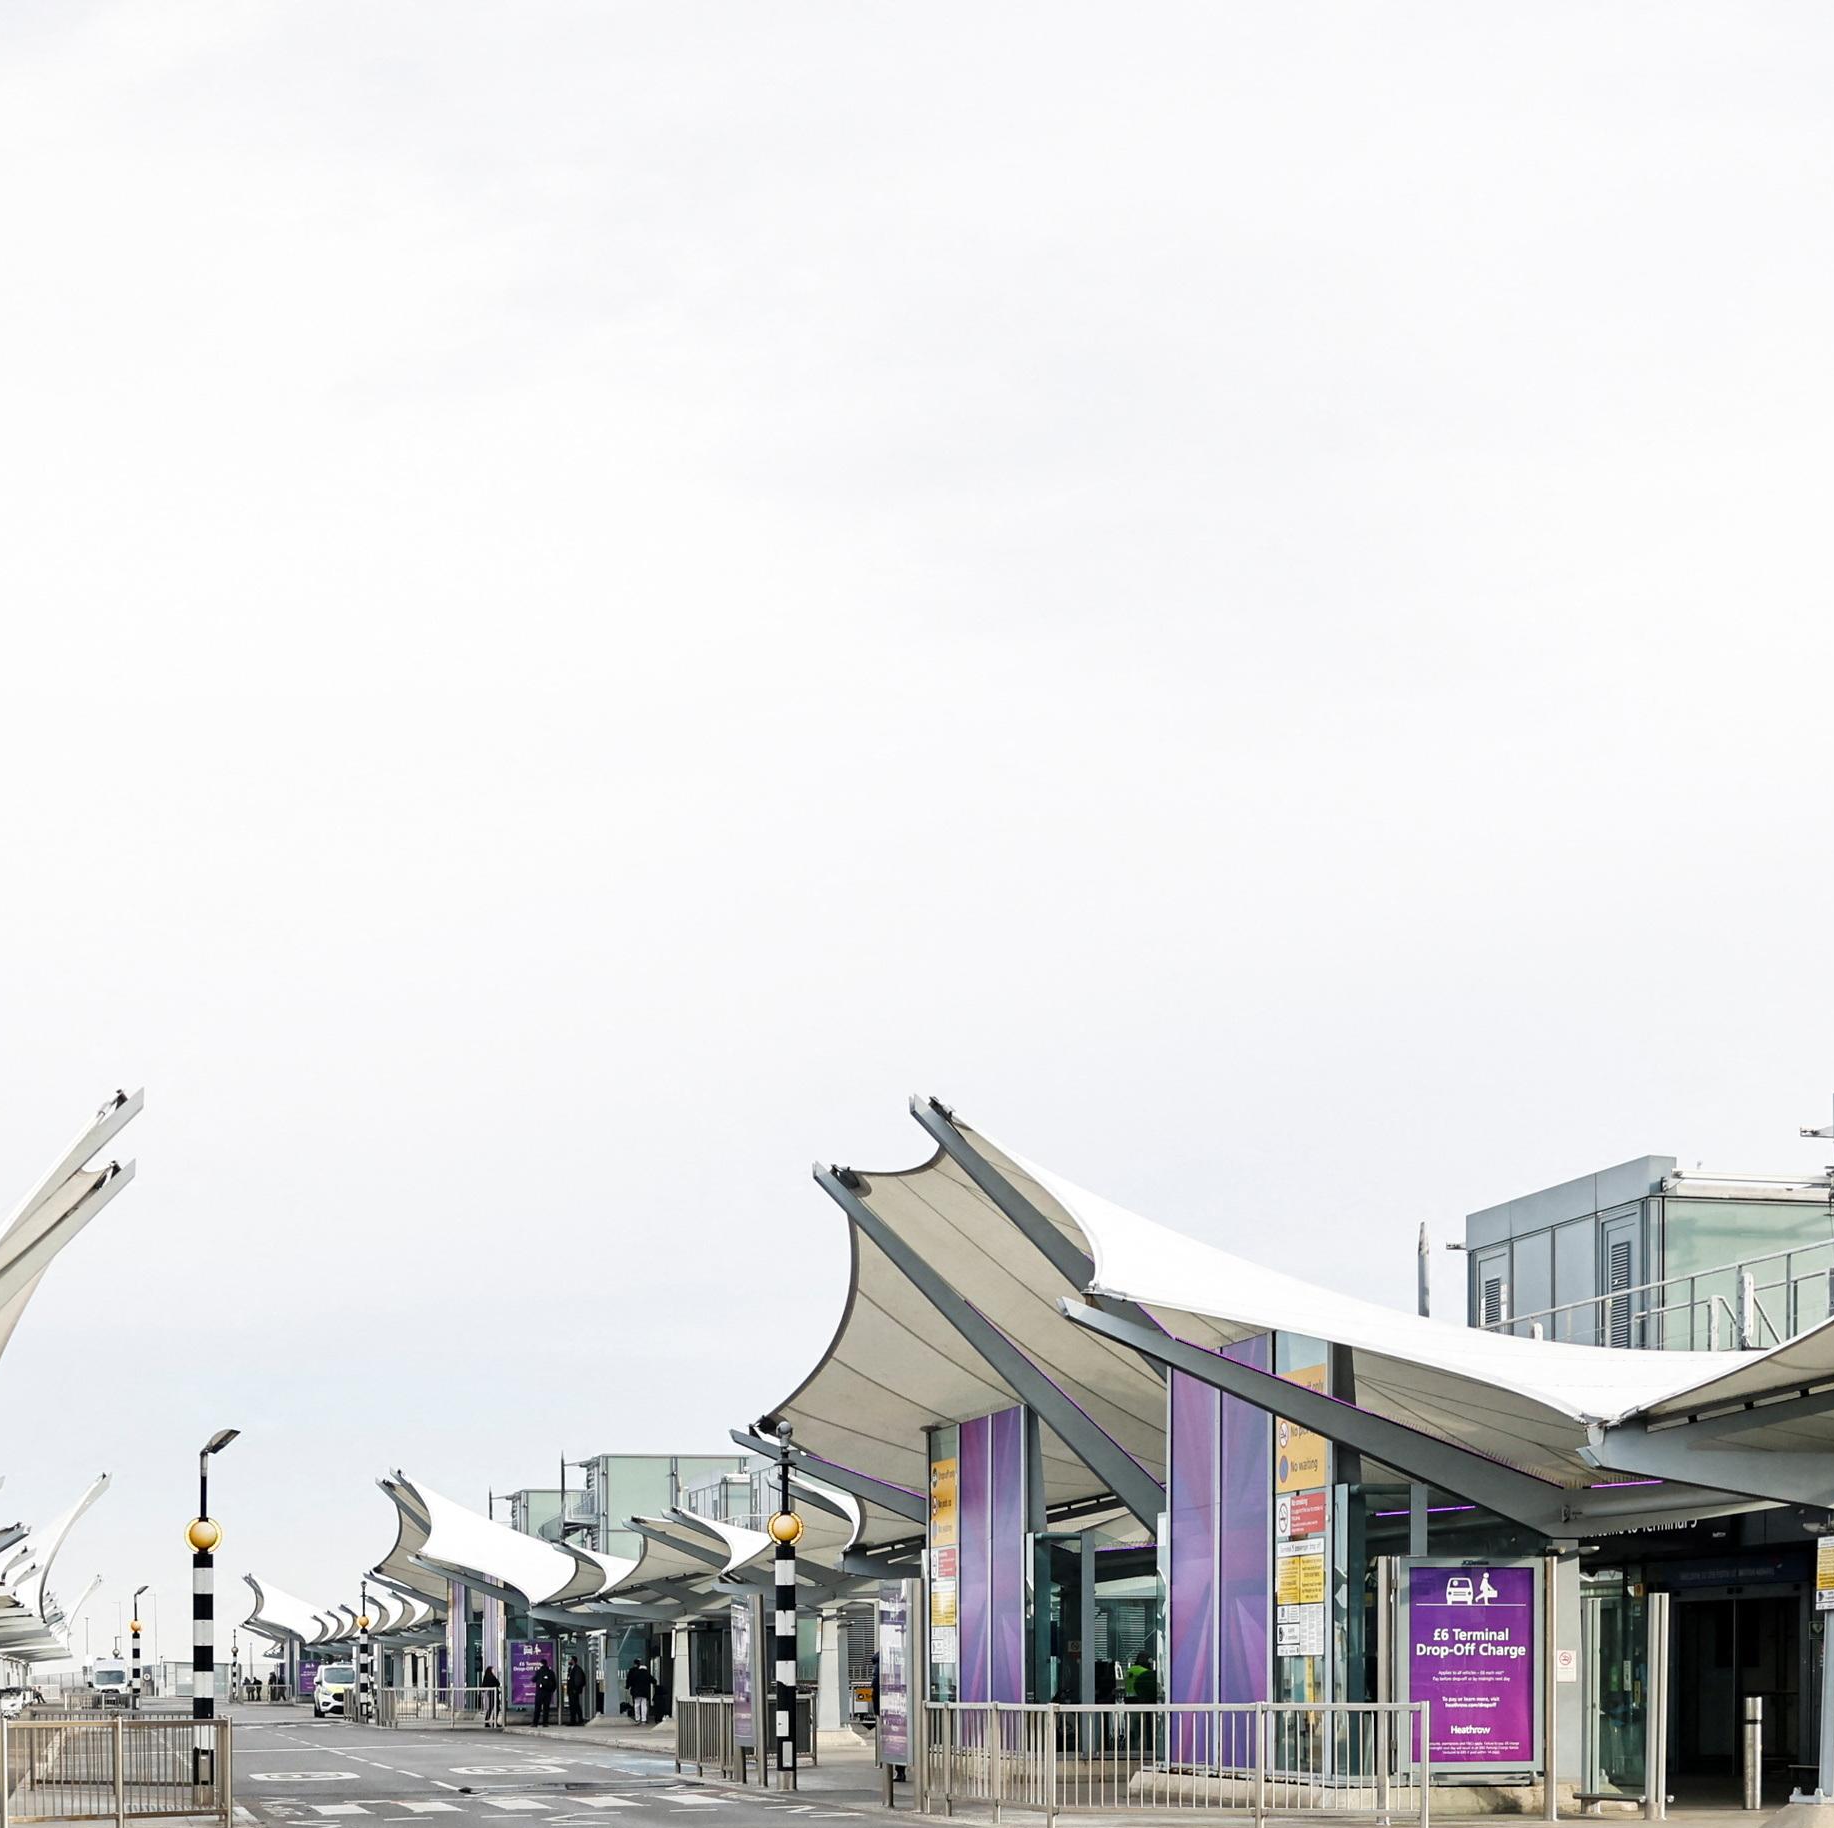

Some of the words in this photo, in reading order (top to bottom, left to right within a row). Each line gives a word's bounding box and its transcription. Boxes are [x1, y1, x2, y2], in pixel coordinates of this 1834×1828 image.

[1433, 1628, 1449, 1641] £6
[1453, 1628, 1509, 1641] Terminal
[1416, 1643, 1475, 1659] Drop-Off
[1479, 1643, 1526, 1659] Charge
[1451, 1725, 1491, 1734] Heathrow
